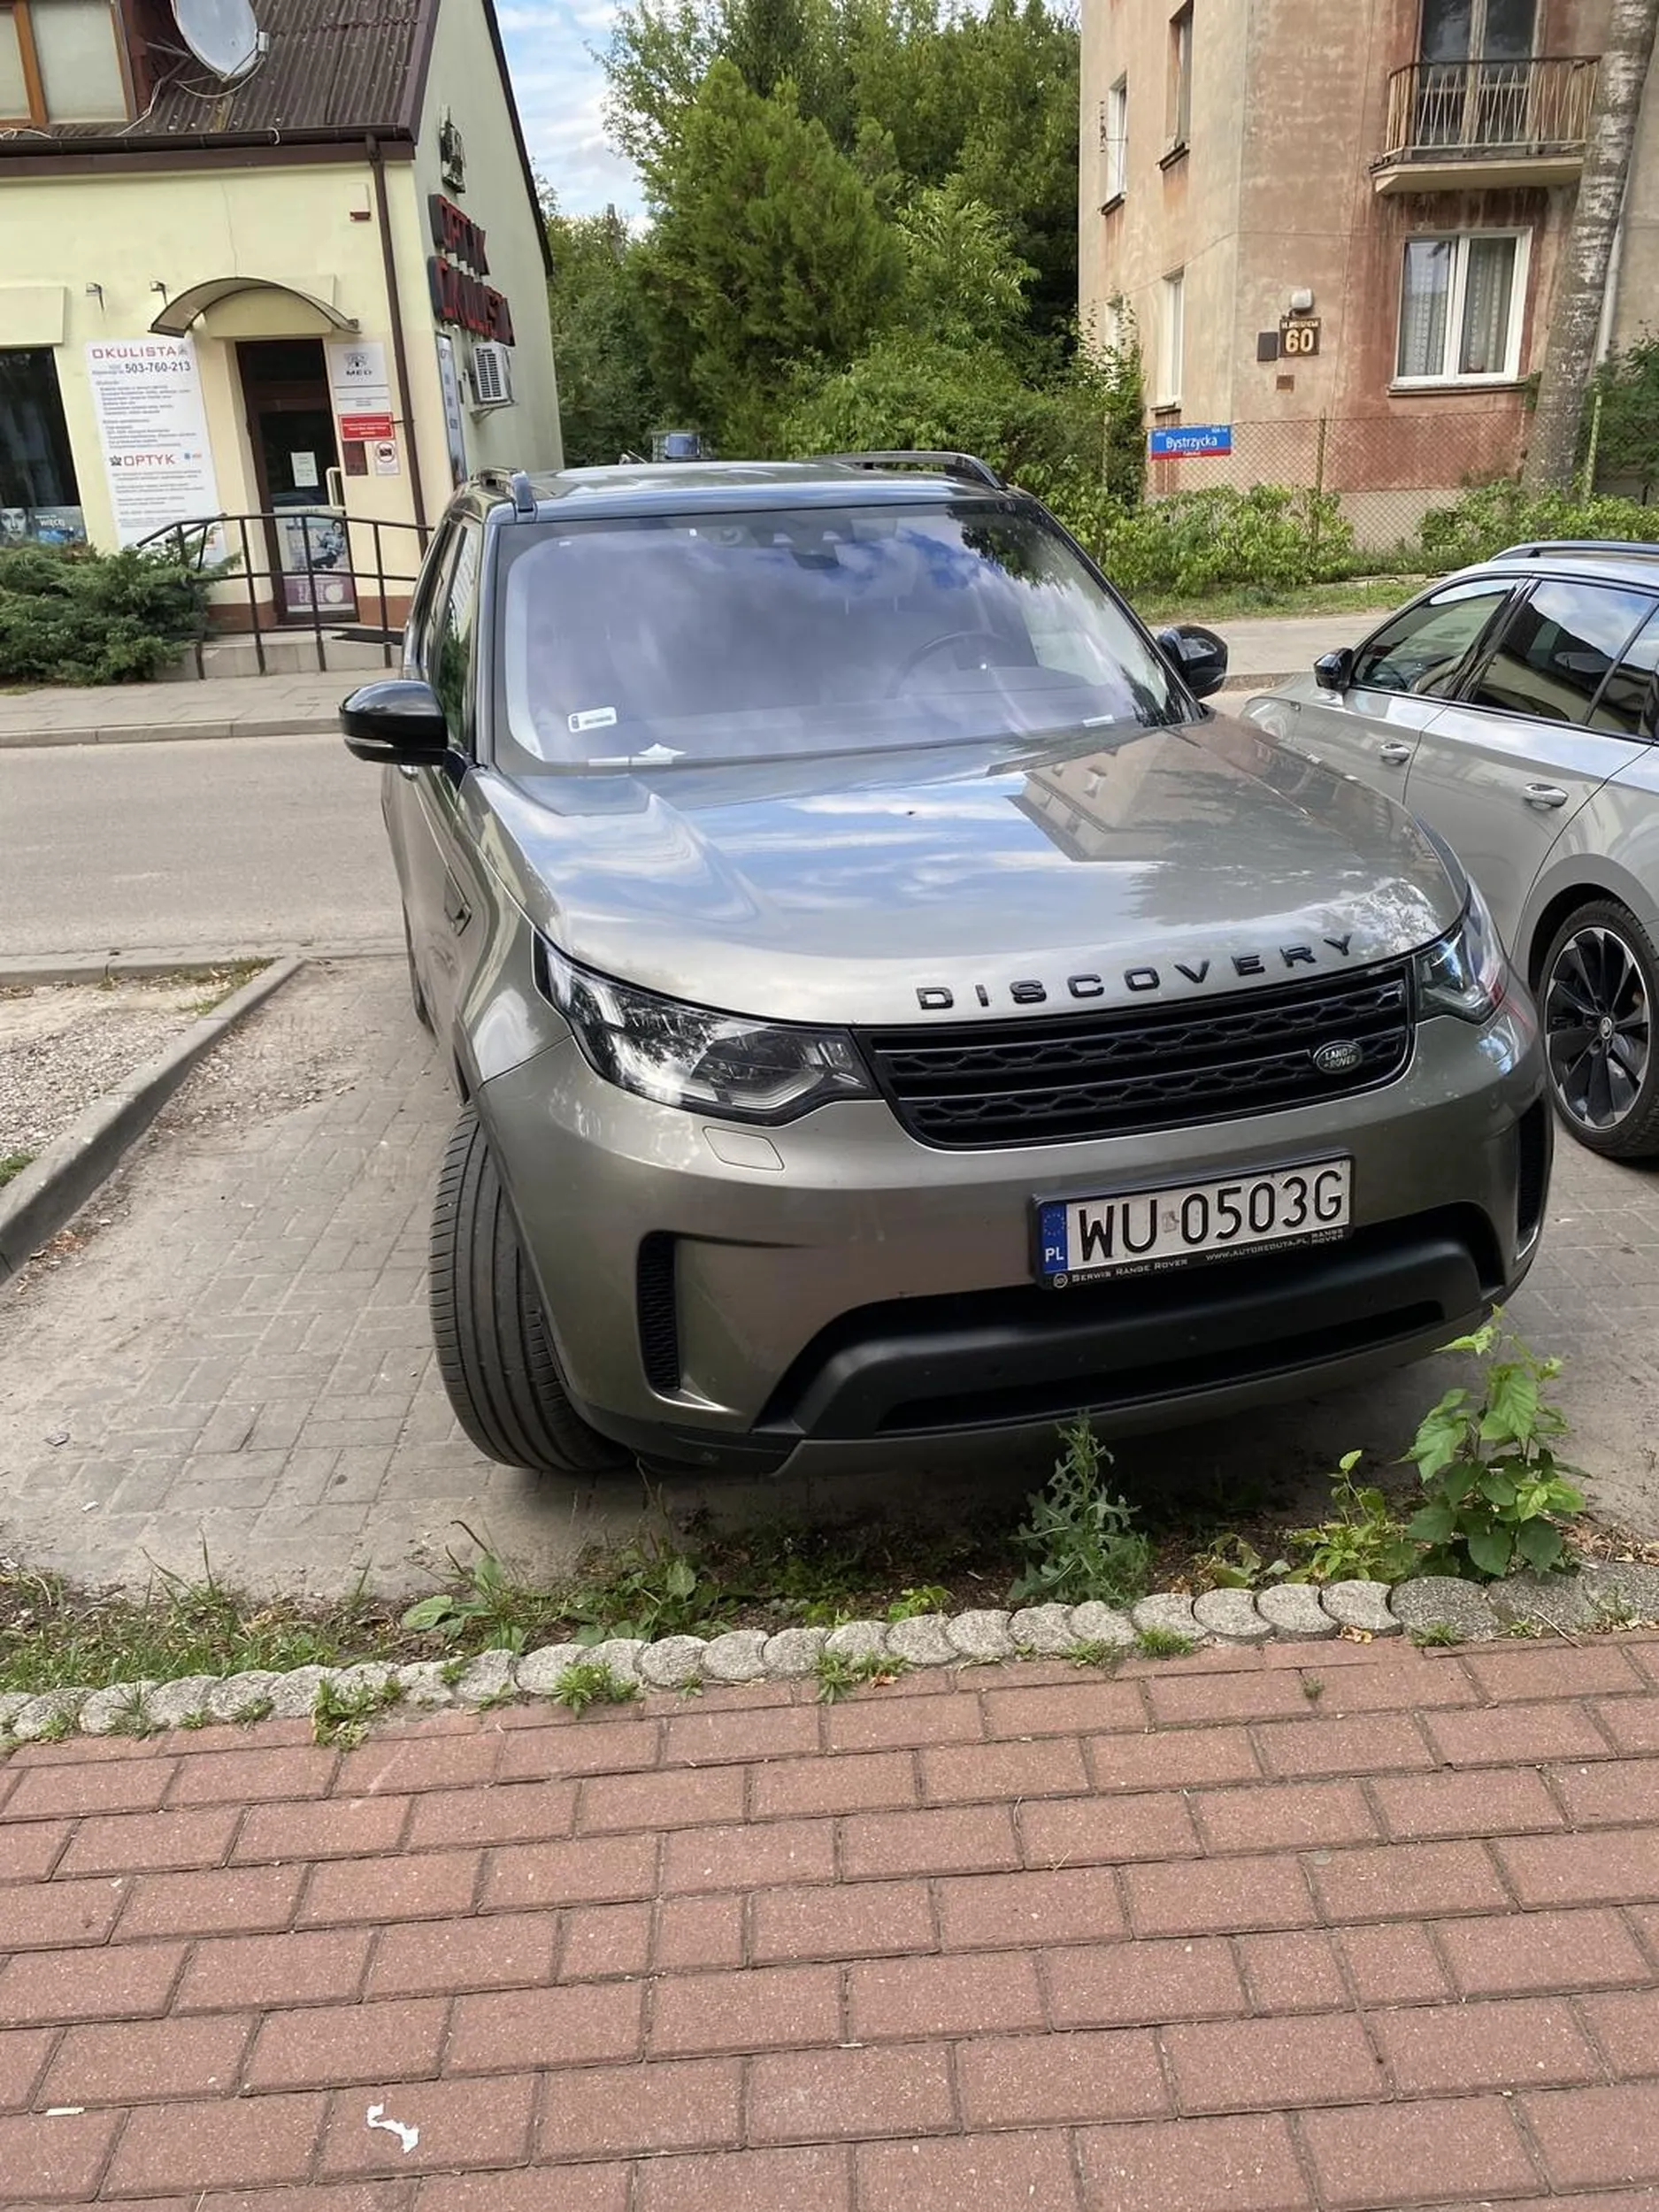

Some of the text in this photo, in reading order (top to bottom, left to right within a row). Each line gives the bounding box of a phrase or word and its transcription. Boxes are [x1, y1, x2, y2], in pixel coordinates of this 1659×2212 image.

[1286, 328, 1314, 352] 60
[92, 346, 177, 359] OKULISTA
[125, 360, 191, 374] 503-760-213
[1166, 434, 1218, 451] Bystrzycka
[124, 453, 175, 467] OPTYK
[916, 933, 1352, 1010] DISCOVERY
[1325, 1048, 1348, 1061] LAND
[1330, 1055, 1356, 1069] ROVER
[1078, 1170, 1342, 1262] WU 0503G
[1045, 1247, 1064, 1263] PL
[1205, 1237, 1308, 1261] WWW.AUTOREDUTA.PL
[1071, 1258, 1188, 1283] SERWIS RANGE ROVER
